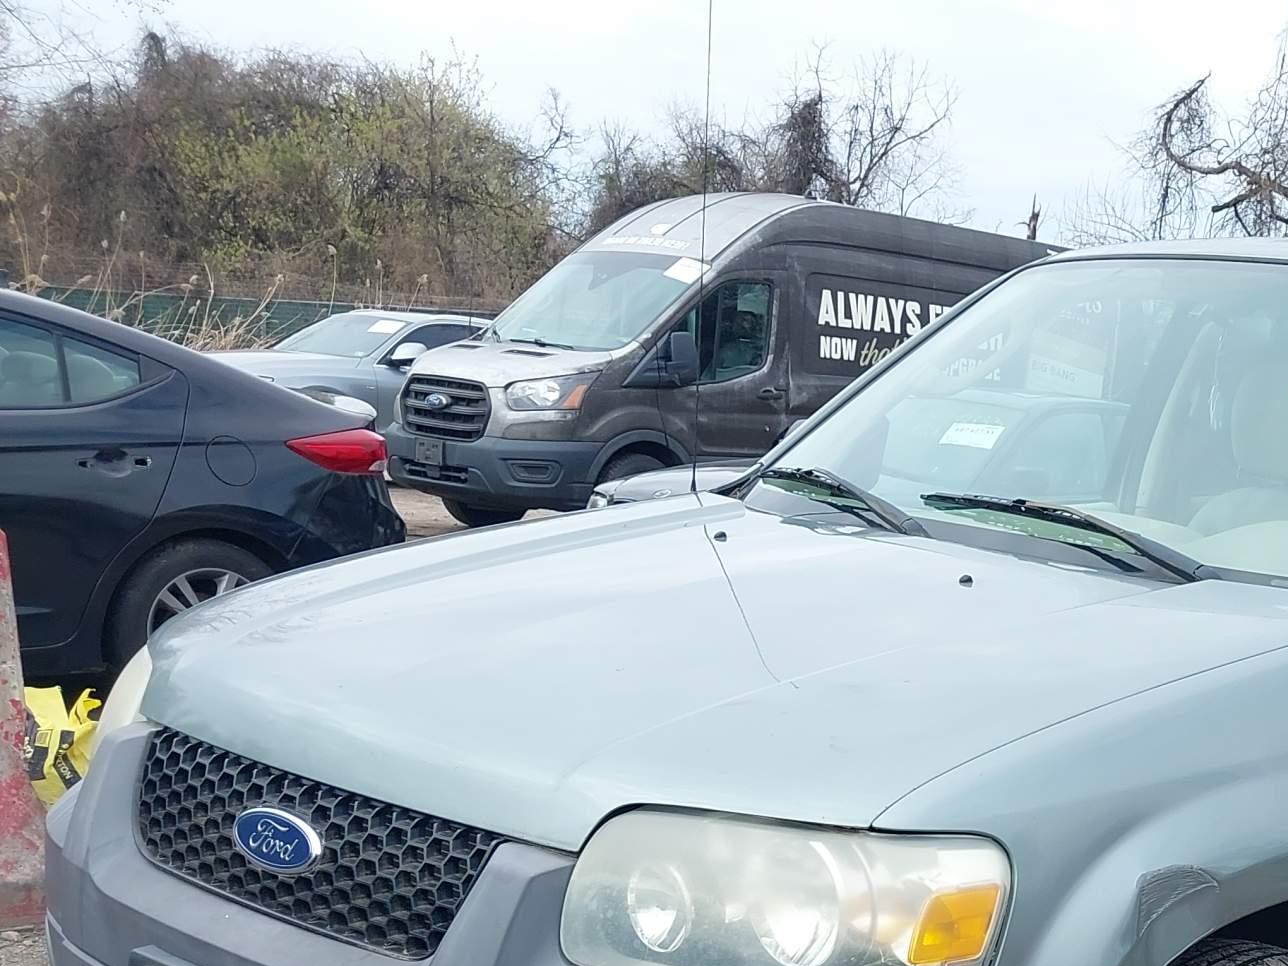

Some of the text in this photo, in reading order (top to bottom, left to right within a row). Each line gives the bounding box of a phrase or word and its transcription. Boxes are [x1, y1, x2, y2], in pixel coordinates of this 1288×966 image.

[818, 289, 921, 336] ALWAYS
[819, 335, 857, 361] NOW
[249, 819, 298, 861] Ford
